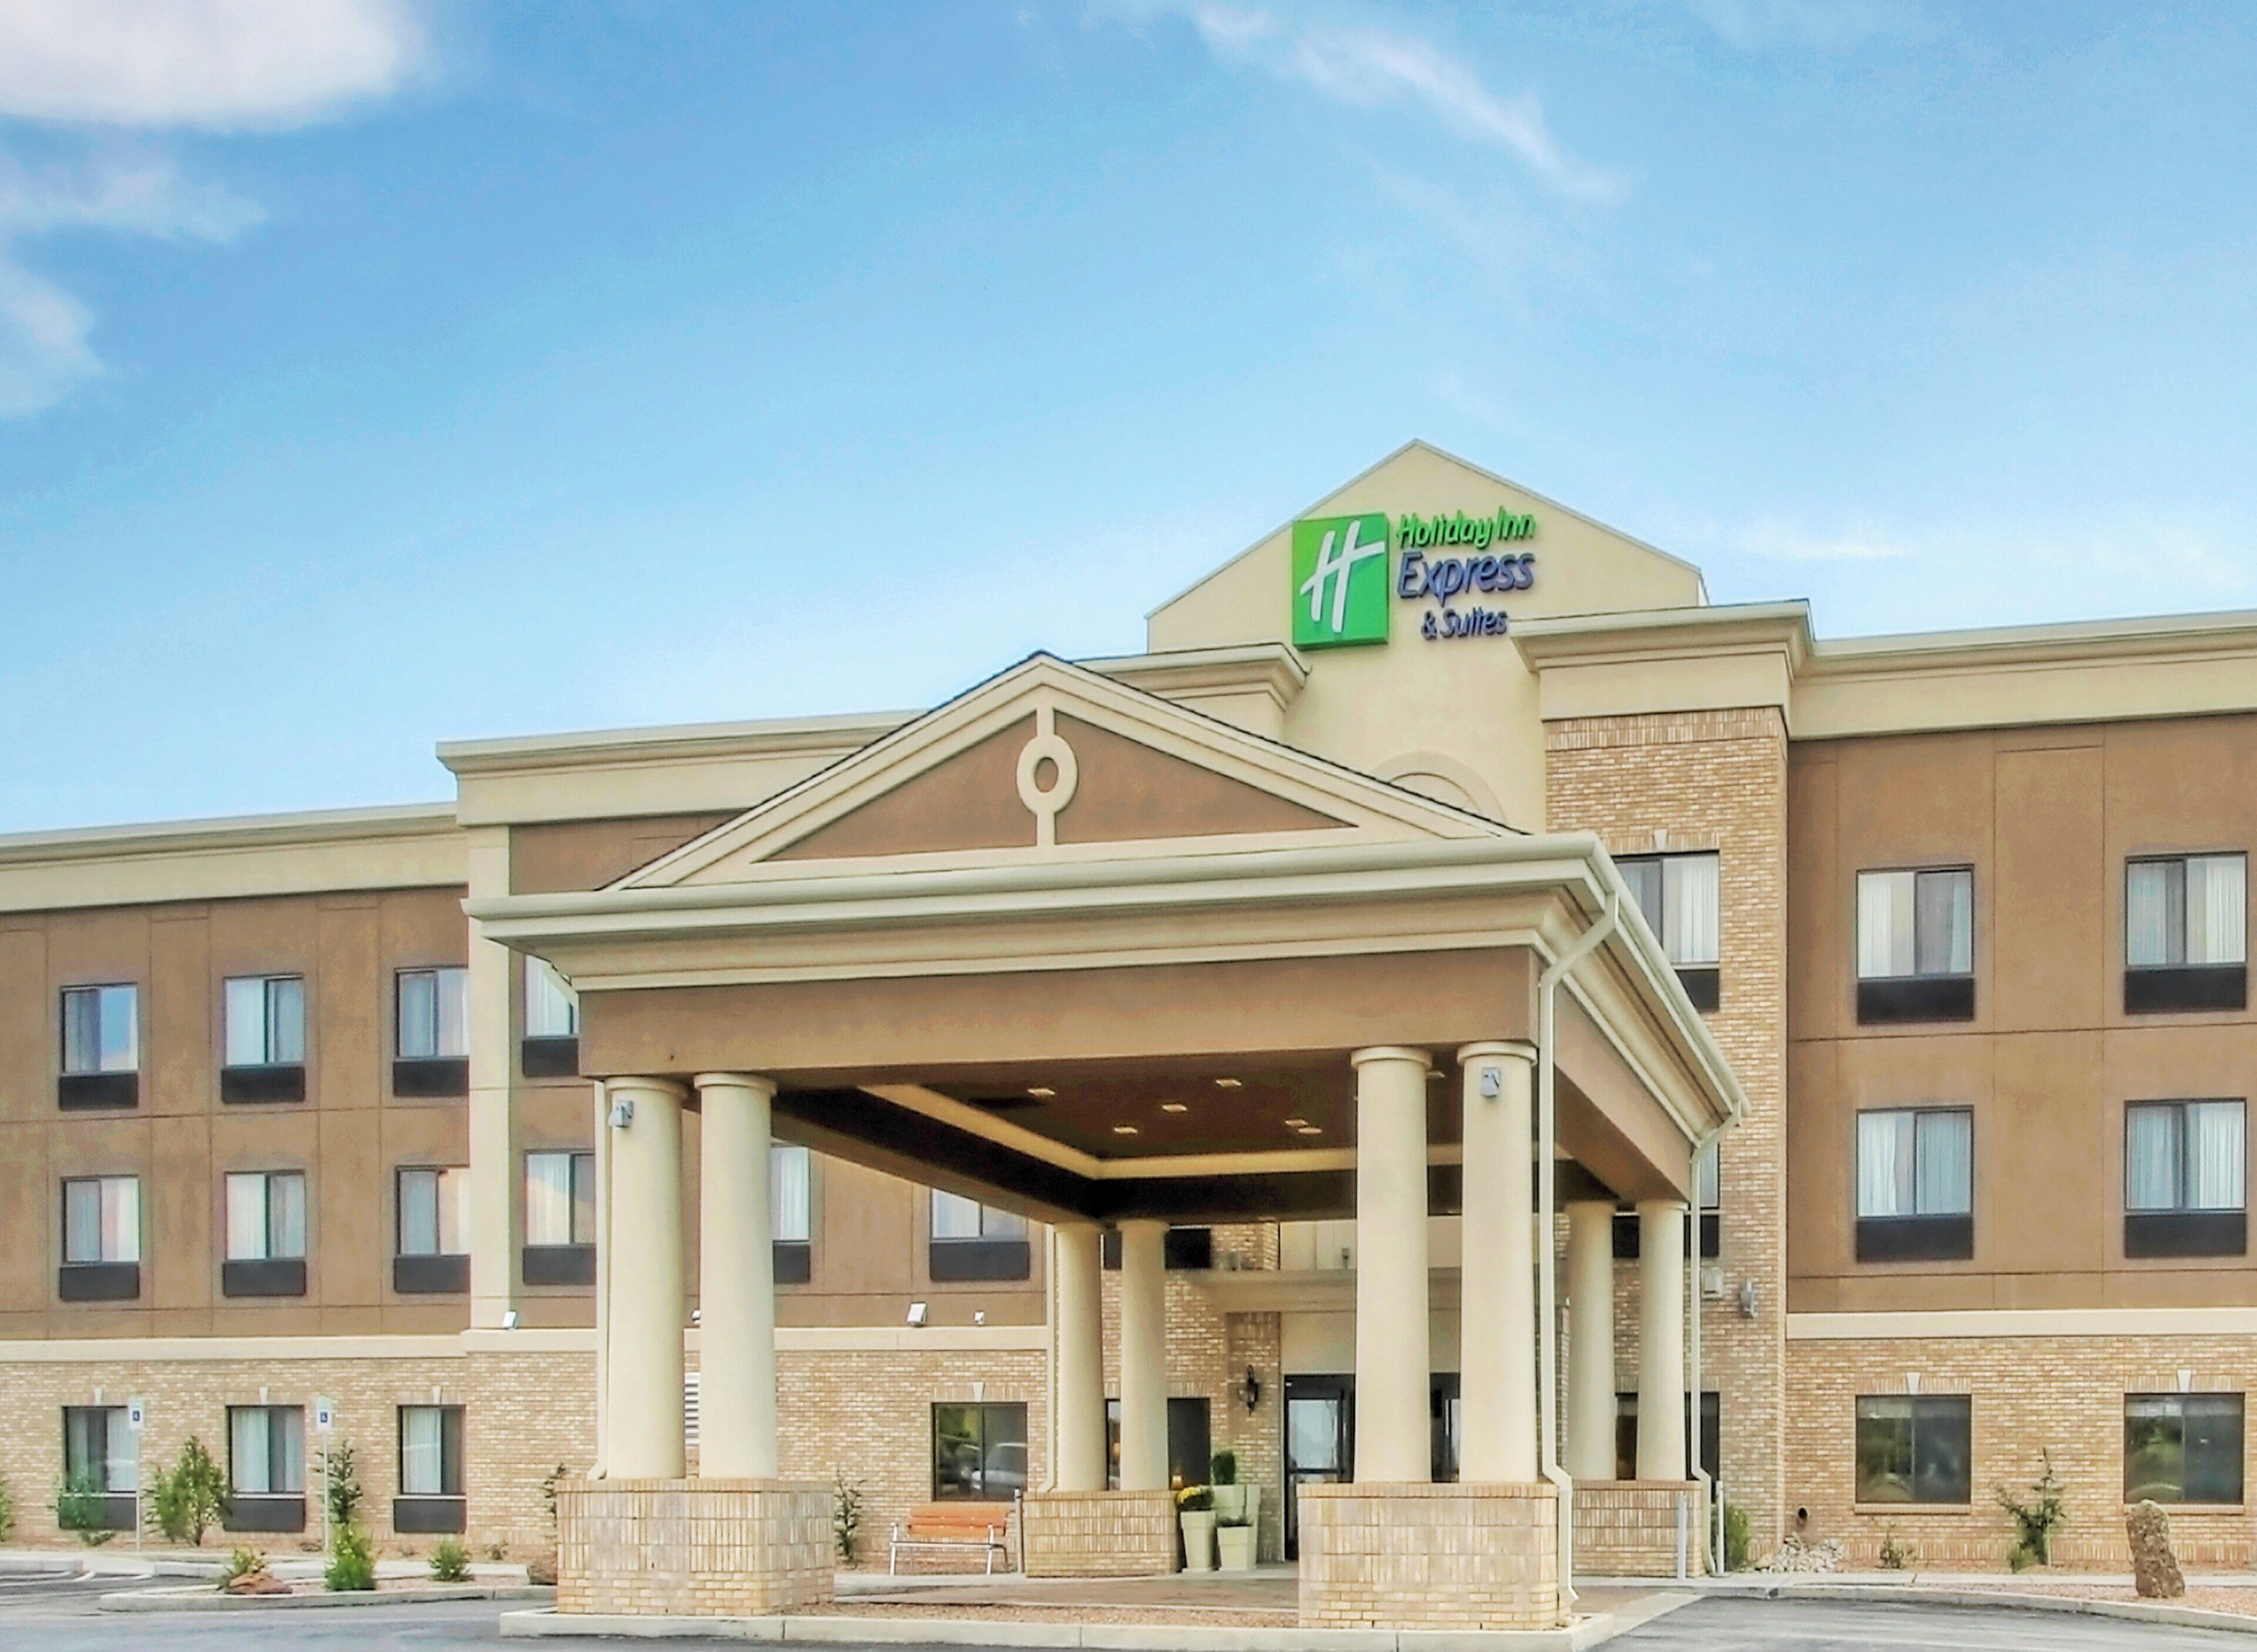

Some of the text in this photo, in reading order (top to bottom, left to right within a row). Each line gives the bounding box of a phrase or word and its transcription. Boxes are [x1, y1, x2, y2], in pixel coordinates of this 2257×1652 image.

[1397, 505, 1536, 549] Holiday Inn
[1397, 551, 1536, 608] Express
[1421, 606, 1508, 640] & Suites
